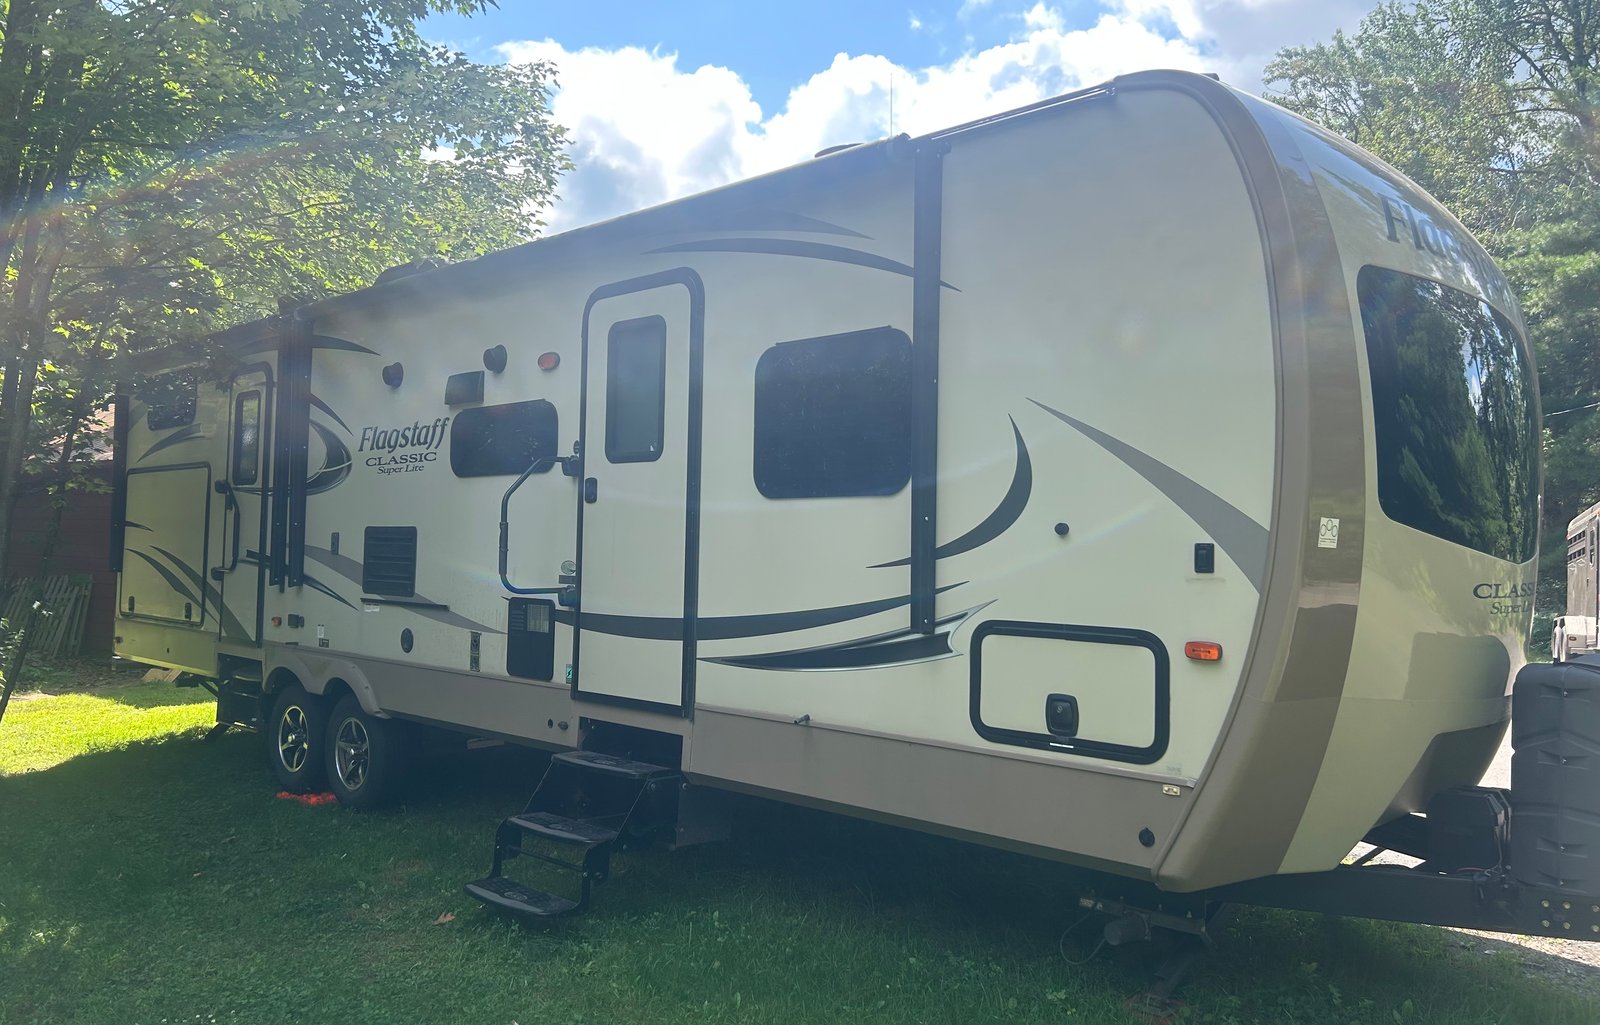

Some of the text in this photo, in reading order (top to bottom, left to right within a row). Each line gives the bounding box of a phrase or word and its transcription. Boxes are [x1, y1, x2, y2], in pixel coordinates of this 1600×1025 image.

[358, 417, 450, 453] Flagstaff
[365, 452, 437, 467] CLASSIC
[377, 464, 425, 475] Super Lite
[1472, 583, 1534, 599] CLASS
[1490, 601, 1522, 617] Super
